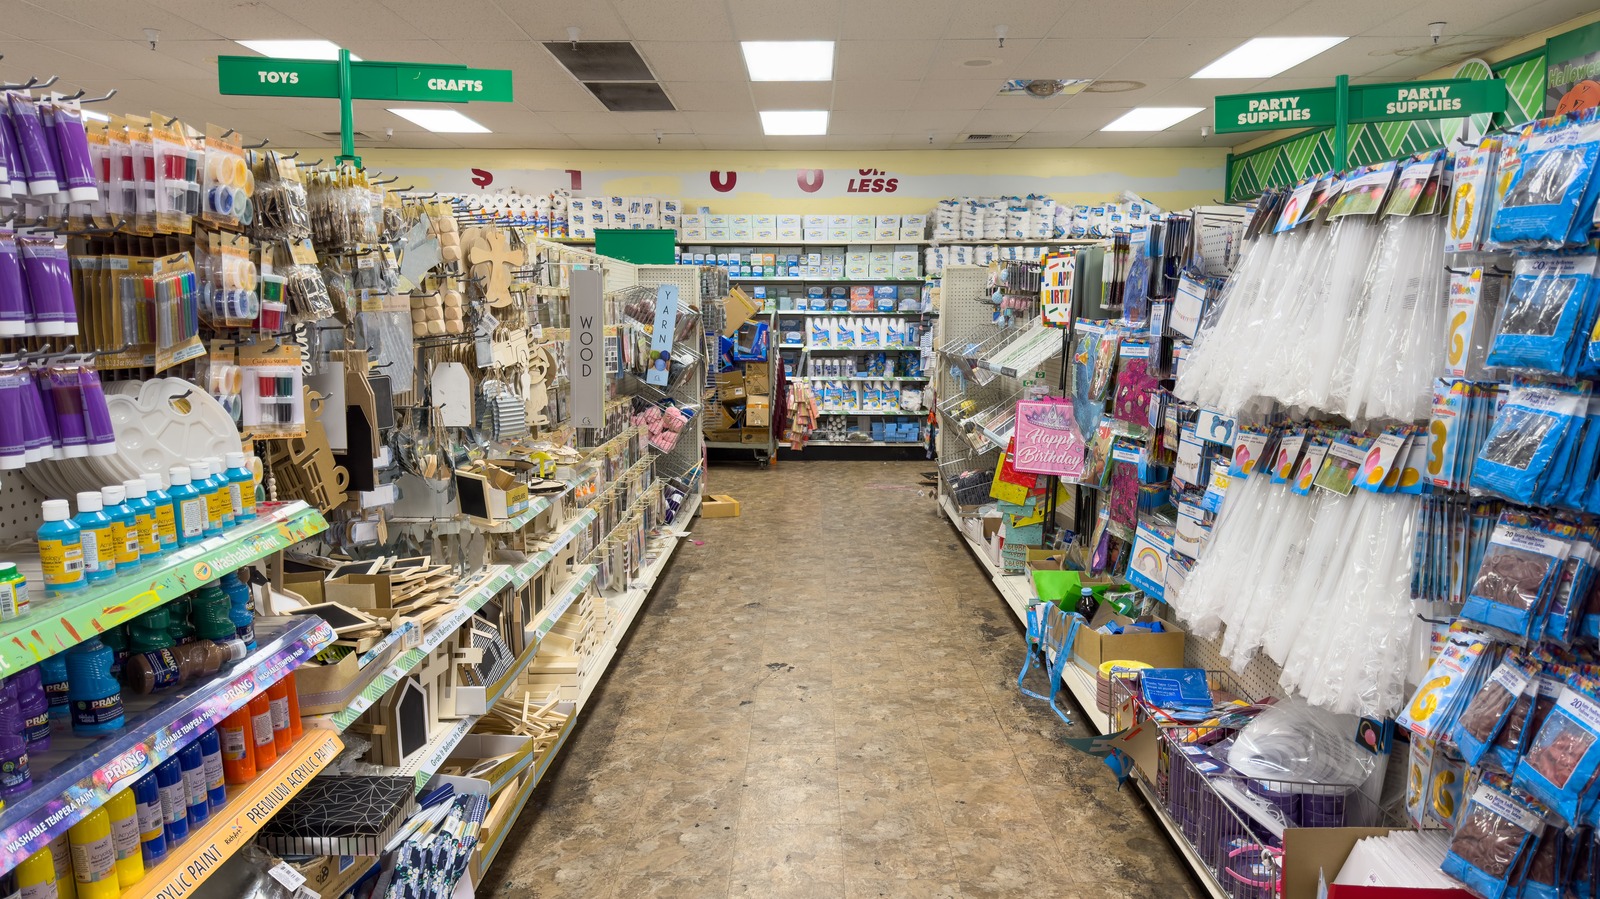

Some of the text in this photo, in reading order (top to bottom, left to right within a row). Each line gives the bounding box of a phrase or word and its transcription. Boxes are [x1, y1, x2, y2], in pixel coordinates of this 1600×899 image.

[257, 71, 299, 84] TOYS
[427, 78, 484, 92] CRAFTS
[1548, 61, 1600, 89] Hallowee
[1397, 86, 1450, 101] PARTY
[1248, 97, 1300, 112] PARTY
[1386, 98, 1462, 115] SUPPLIES
[1237, 109, 1311, 125] SUPPLIES
[847, 178, 899, 193] LESS
[658, 290, 672, 344] YARN
[580, 315, 594, 378] WOOD
[1026, 428, 1077, 451] Happy
[1018, 446, 1083, 471] Birthday
[208, 543, 259, 572] Washable
[306, 626, 331, 646] PRANG
[160, 648, 178, 672] PRANG
[222, 678, 253, 703] PRANG
[91, 694, 121, 709] PRANG
[1570, 697, 1582, 709] 20
[26, 712, 49, 727] PRAN
[153, 706, 218, 753] WASHABLE TEMPERA PAINT
[442, 738, 456, 753] Before
[104, 750, 146, 783] PRANG
[246, 737, 339, 825] PREMIUM ACRYLIC PAINT
[1485, 793, 1494, 801] 20
[6, 788, 96, 854] WASHABLE TEMPERA PAINT
[224, 828, 243, 846] RichArt
[186, 843, 224, 881] PAINT
